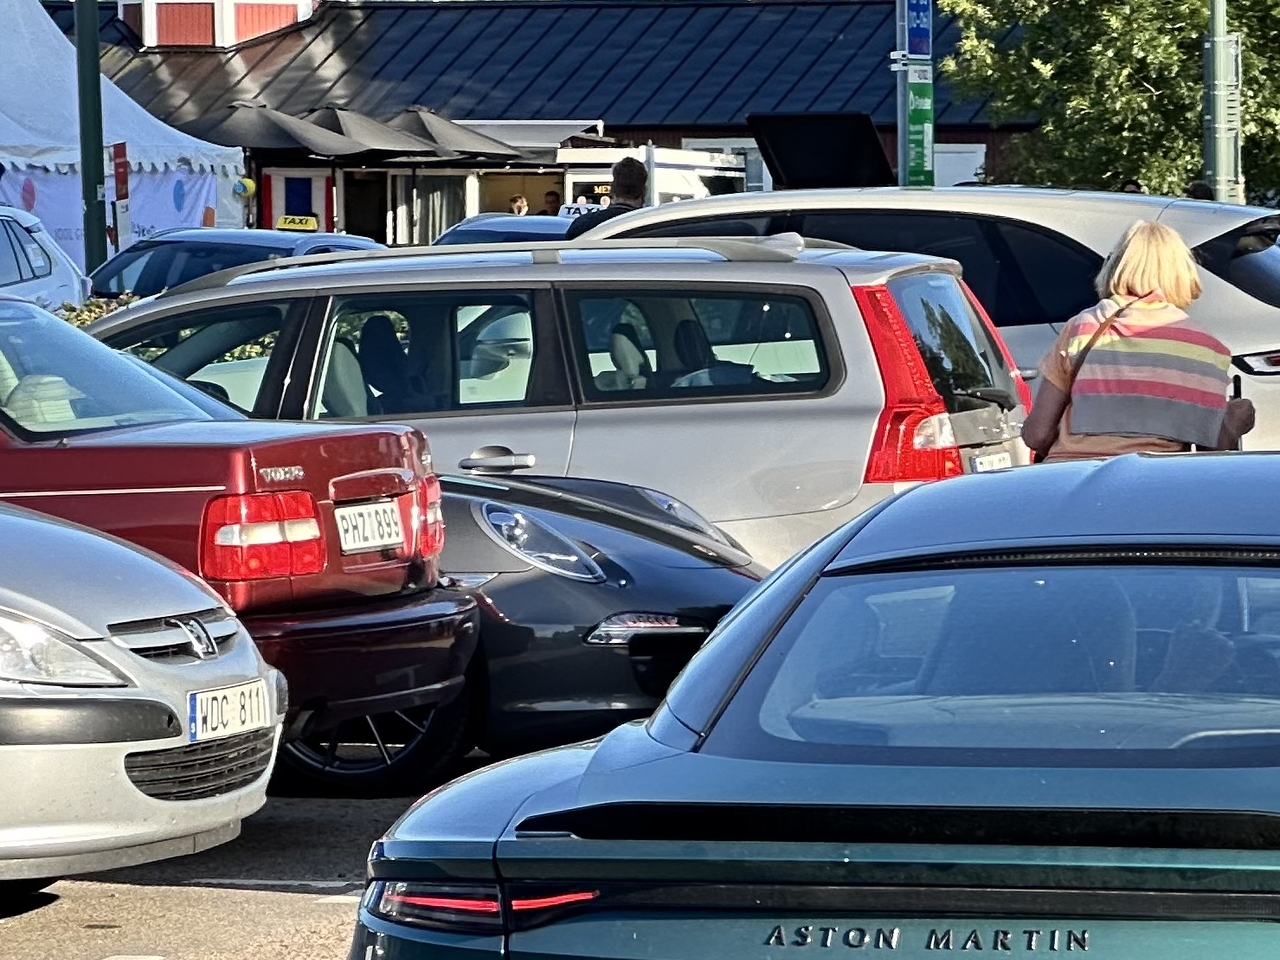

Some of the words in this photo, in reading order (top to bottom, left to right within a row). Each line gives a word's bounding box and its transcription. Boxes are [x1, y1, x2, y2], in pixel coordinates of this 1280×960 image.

[283, 217, 309, 225] TAXI
[565, 206, 600, 216] TAX
[340, 512, 370, 545] PHZ
[377, 507, 400, 540] 899
[201, 694, 229, 734] WDC
[240, 687, 261, 726] 811
[763, 925, 901, 950] ASTON
[925, 928, 1091, 951] MARTIN
